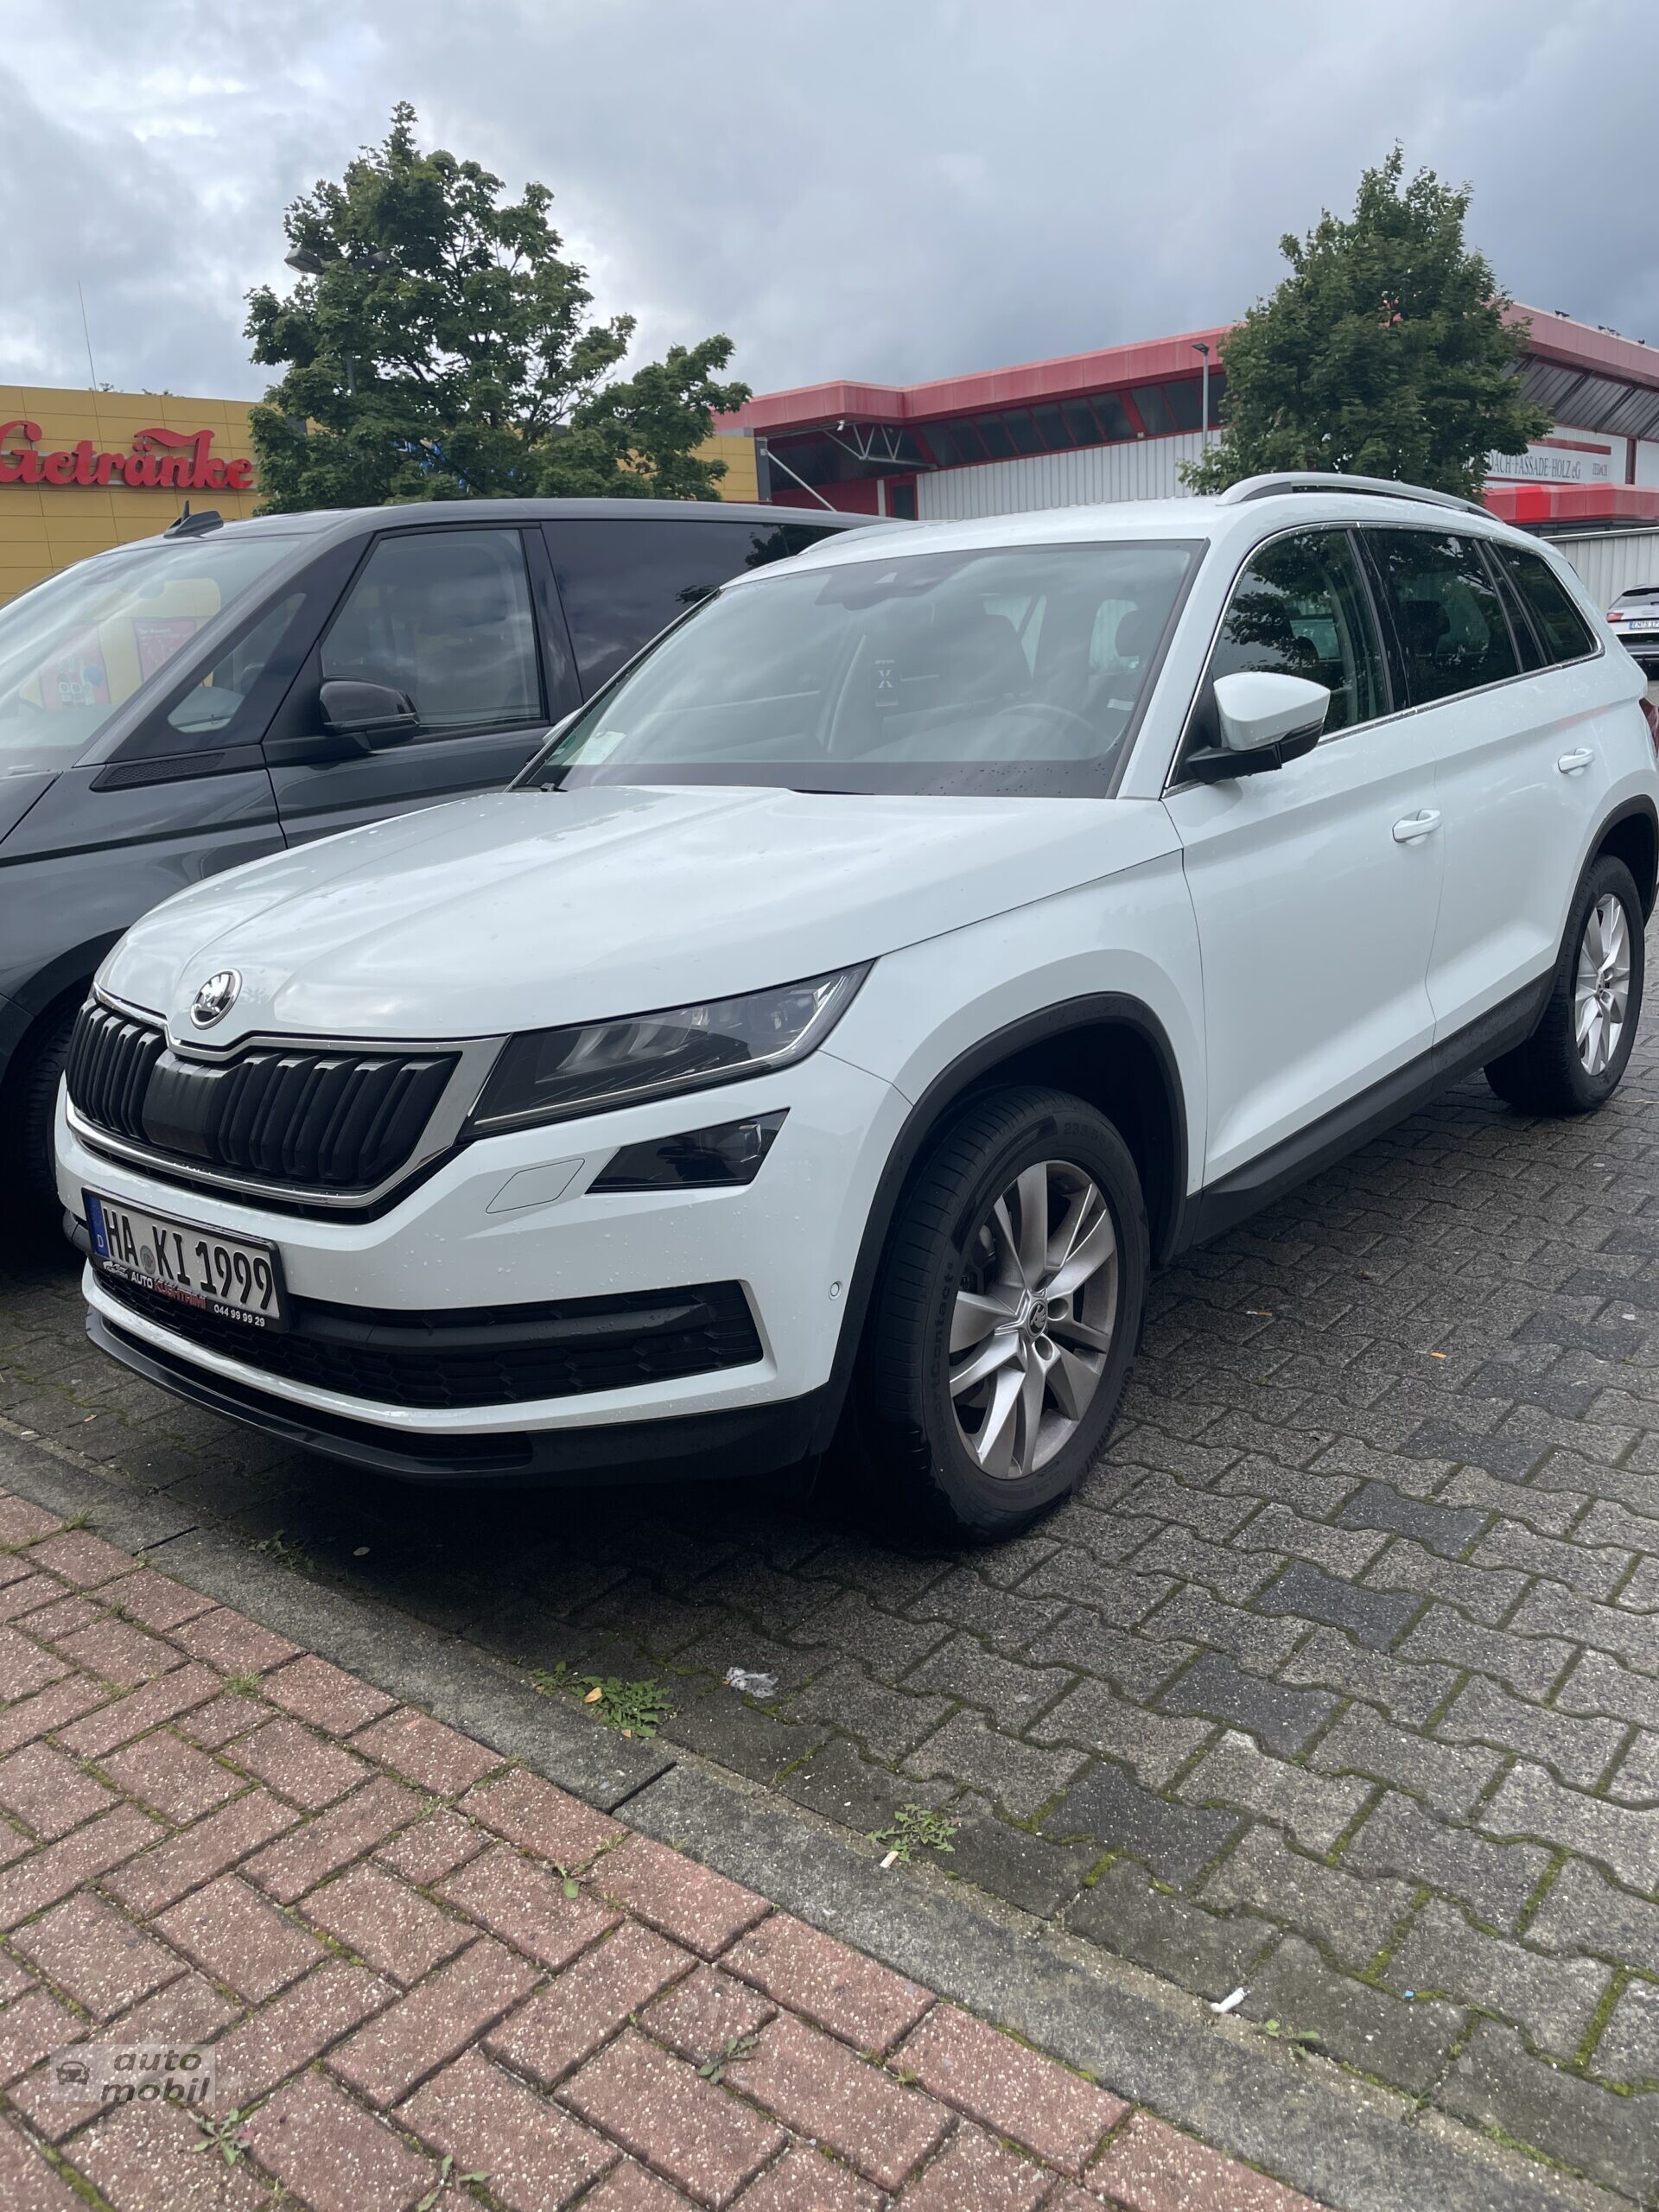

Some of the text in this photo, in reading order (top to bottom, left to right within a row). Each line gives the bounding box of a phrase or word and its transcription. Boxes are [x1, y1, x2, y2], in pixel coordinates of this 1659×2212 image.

[0, 420, 253, 489] Getränke
[98, 1234, 104, 1248] D
[103, 1207, 273, 1310] HA KI 1999
[131, 1271, 154, 1289] AUTO
[213, 1304, 229, 1317] 044
[230, 1309, 241, 1320] 99
[242, 1313, 253, 1324] 99
[254, 1316, 265, 1327] 29
